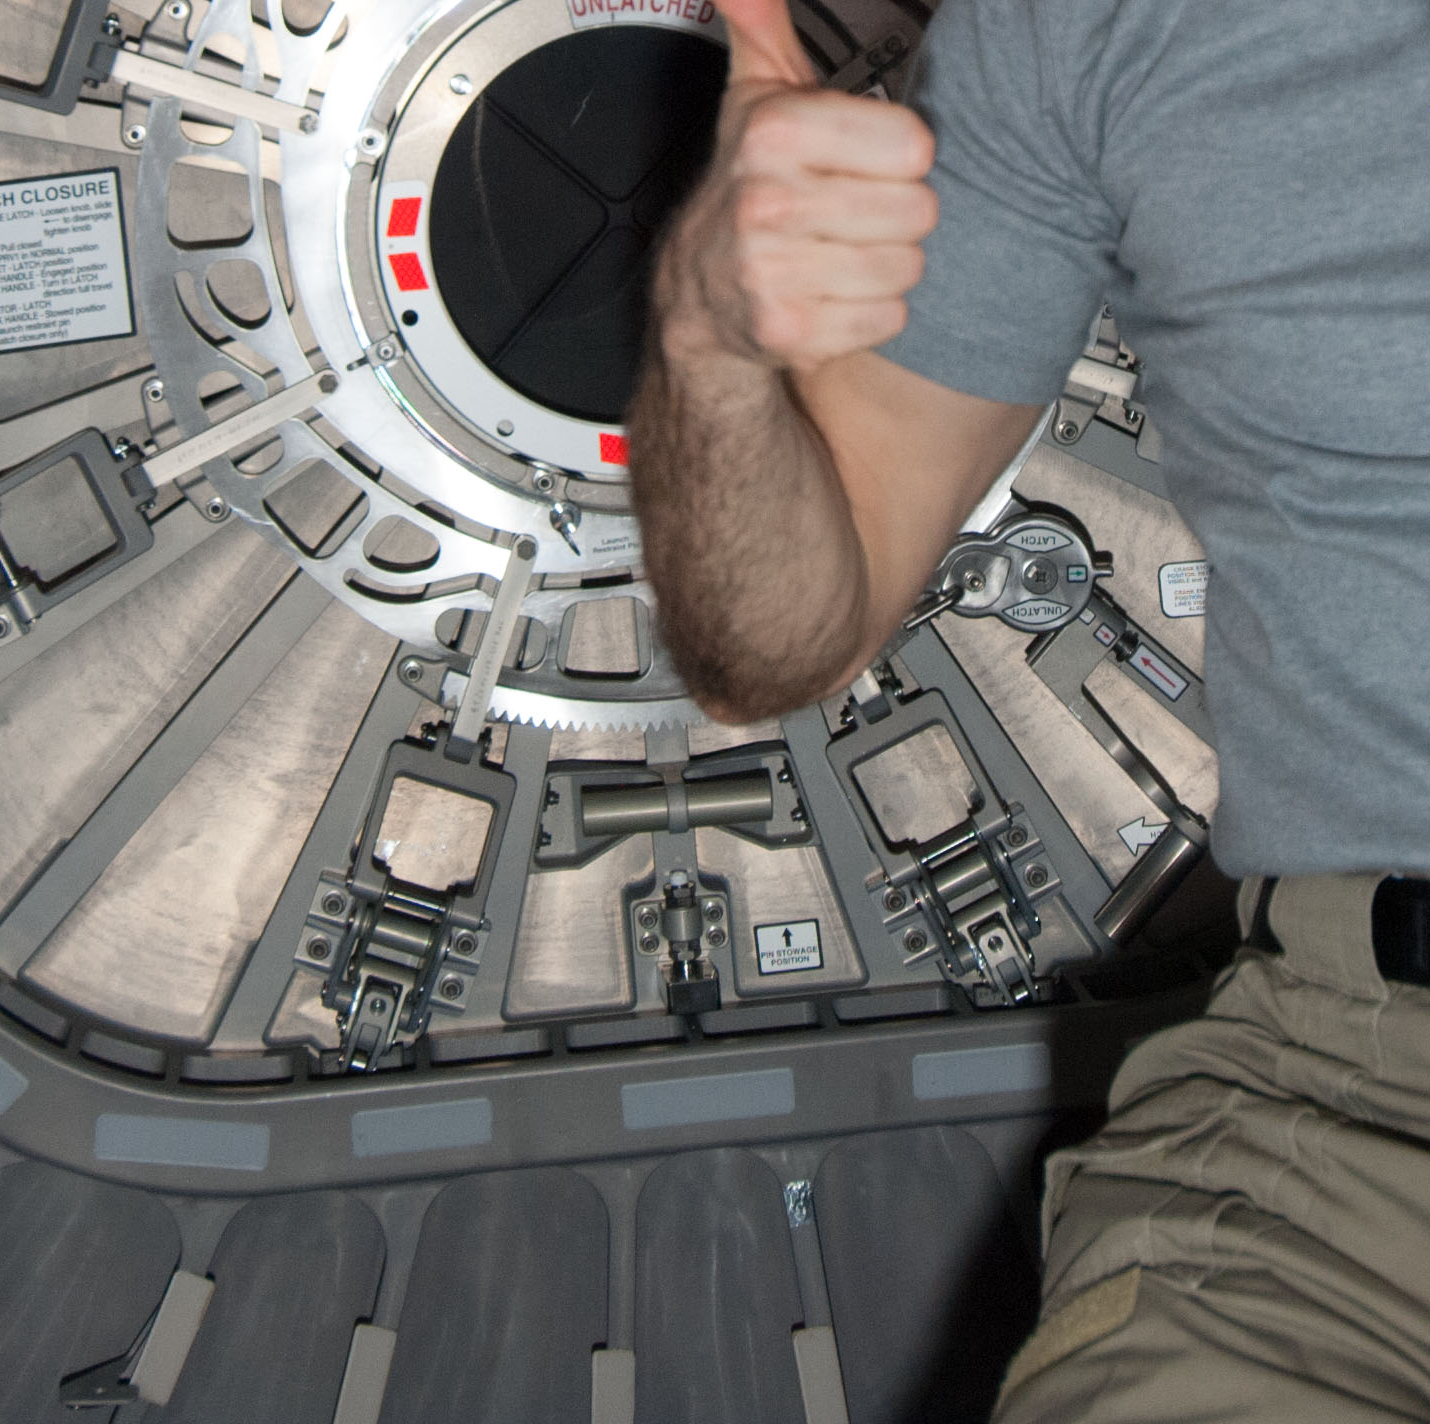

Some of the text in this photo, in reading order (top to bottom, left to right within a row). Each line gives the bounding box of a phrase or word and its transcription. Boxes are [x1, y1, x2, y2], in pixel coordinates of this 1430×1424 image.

[21, 180, 109, 204] CLOSURE
[8, 210, 34, 221] LATCH
[40, 207, 69, 216] Loosen
[68, 244, 99, 254] position
[13, 261, 40, 271] LATCH
[40, 258, 74, 268] position
[0, 271, 34, 282] HANDLE
[77, 263, 107, 274] position
[2, 281, 35, 293] HANDLE
[71, 274, 98, 284] LATCH
[23, 301, 51, 311] LATCH
[5, 312, 39, 323] HANDLE
[1020, 535, 1056, 546] LATCH
[1011, 605, 1063, 618] UNLATCH
[775, 944, 819, 958] STOWAGE
[770, 954, 811, 967] POSITION
